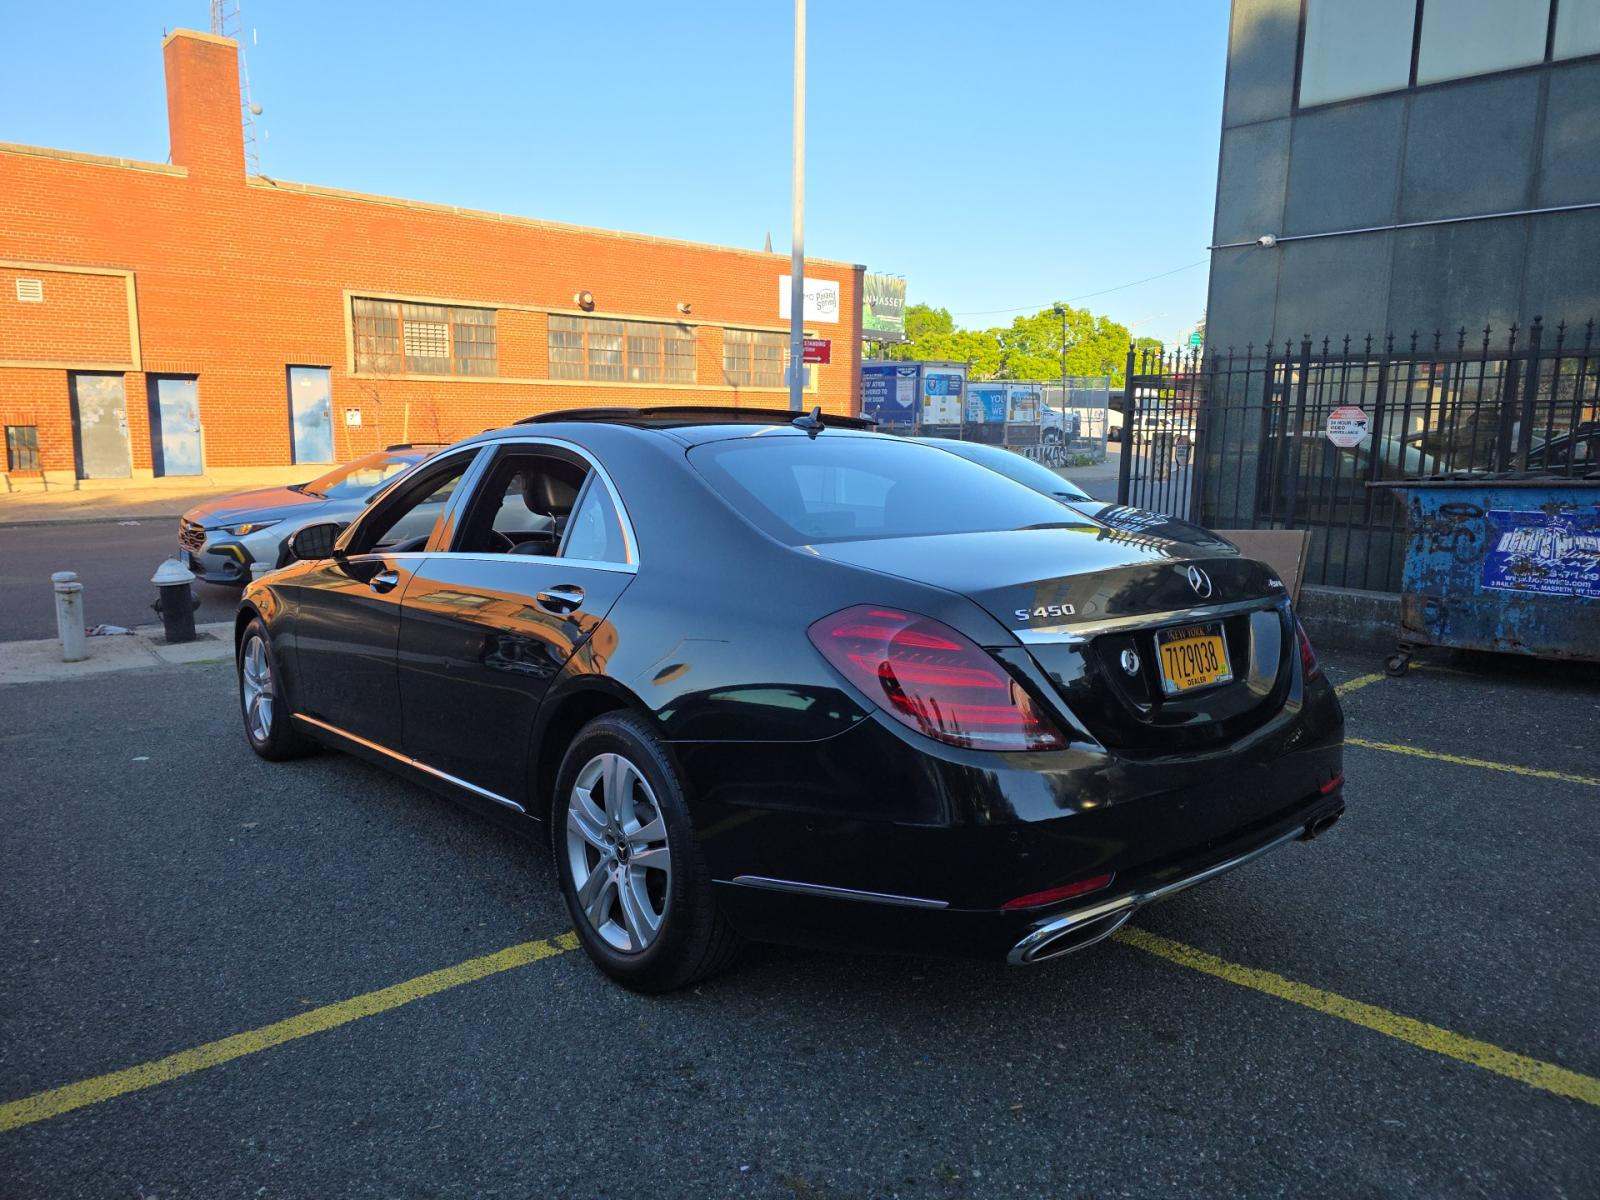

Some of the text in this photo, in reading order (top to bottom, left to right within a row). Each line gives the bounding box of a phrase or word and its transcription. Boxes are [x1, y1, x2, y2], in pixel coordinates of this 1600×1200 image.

[1015, 603, 1076, 621] S 450
[1167, 626, 1205, 641] NEW YORK
[1165, 641, 1218, 680] 7129038
[1186, 676, 1207, 686] DEALER
